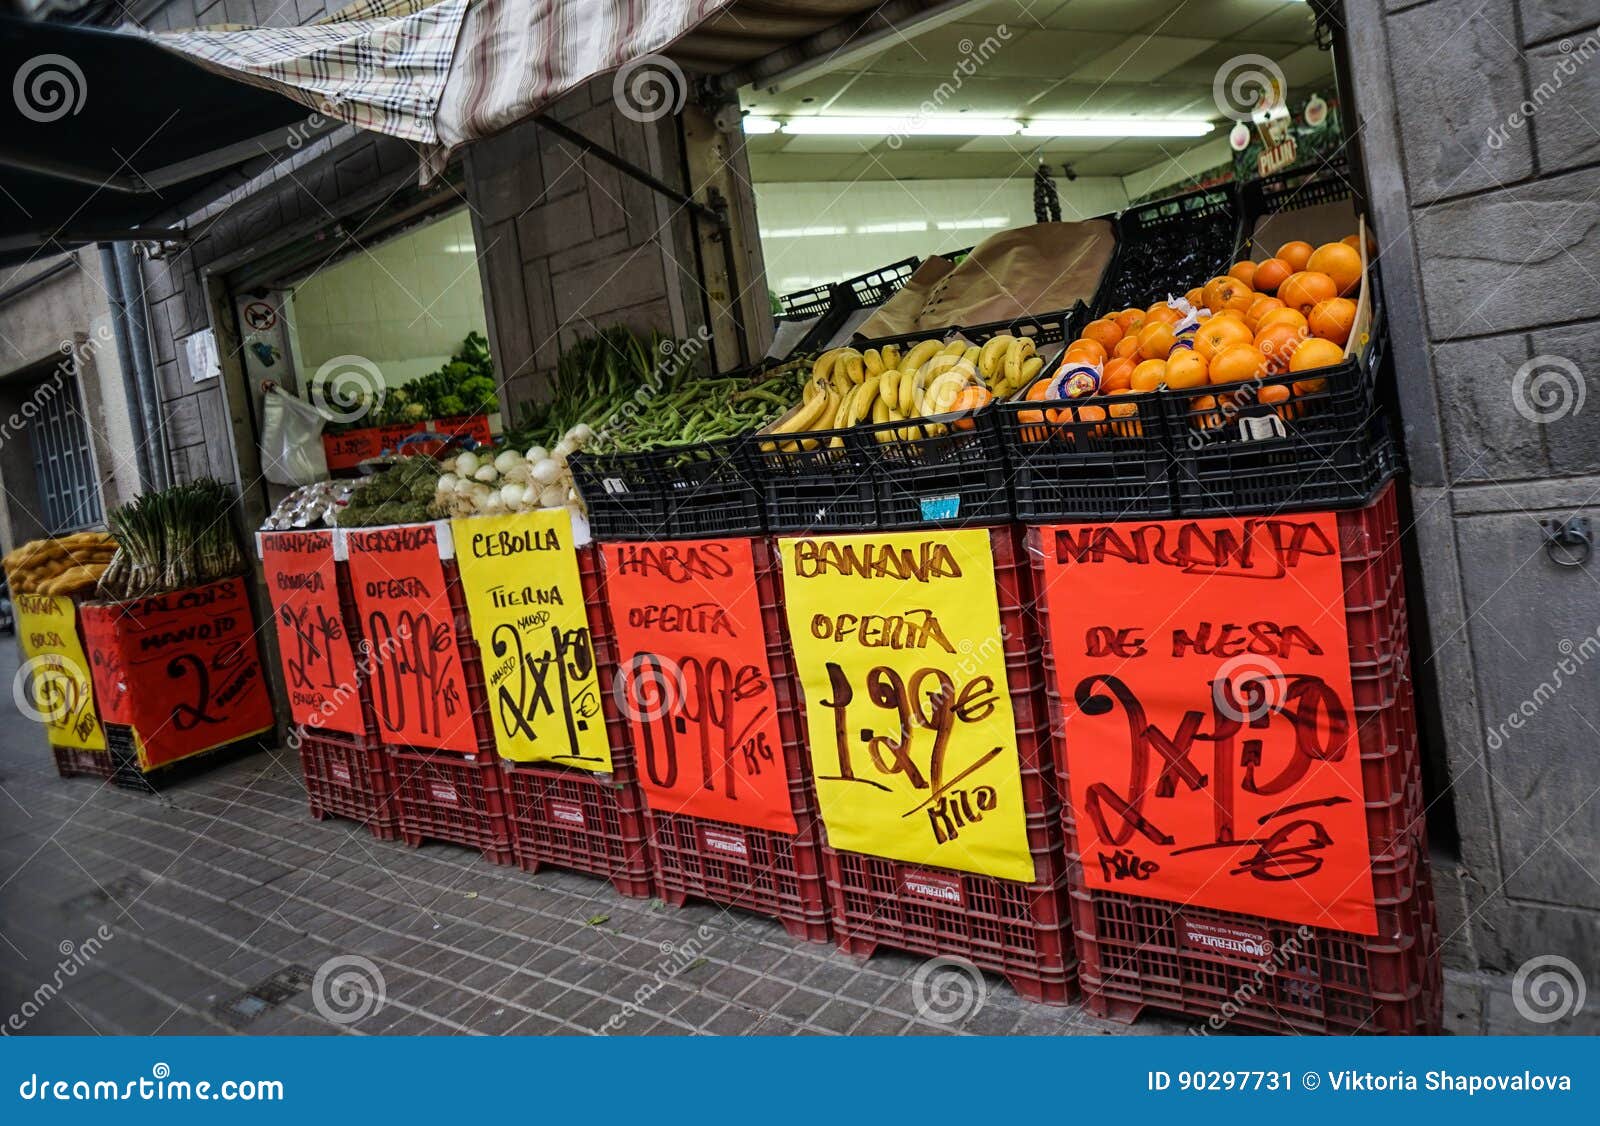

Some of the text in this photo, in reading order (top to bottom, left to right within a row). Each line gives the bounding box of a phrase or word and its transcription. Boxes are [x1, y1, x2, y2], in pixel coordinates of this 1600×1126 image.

[472, 528, 561, 558] CEBOLLA
[794, 540, 963, 583] BANANA
[1055, 520, 1336, 578] NARANJA
[617, 543, 734, 583] HABAS
[366, 577, 431, 600] OFERTA
[486, 585, 564, 608] TIERNA
[629, 604, 737, 638] OFERTA
[811, 608, 957, 653] OFERTA
[1085, 621, 1324, 659] DE MESA
